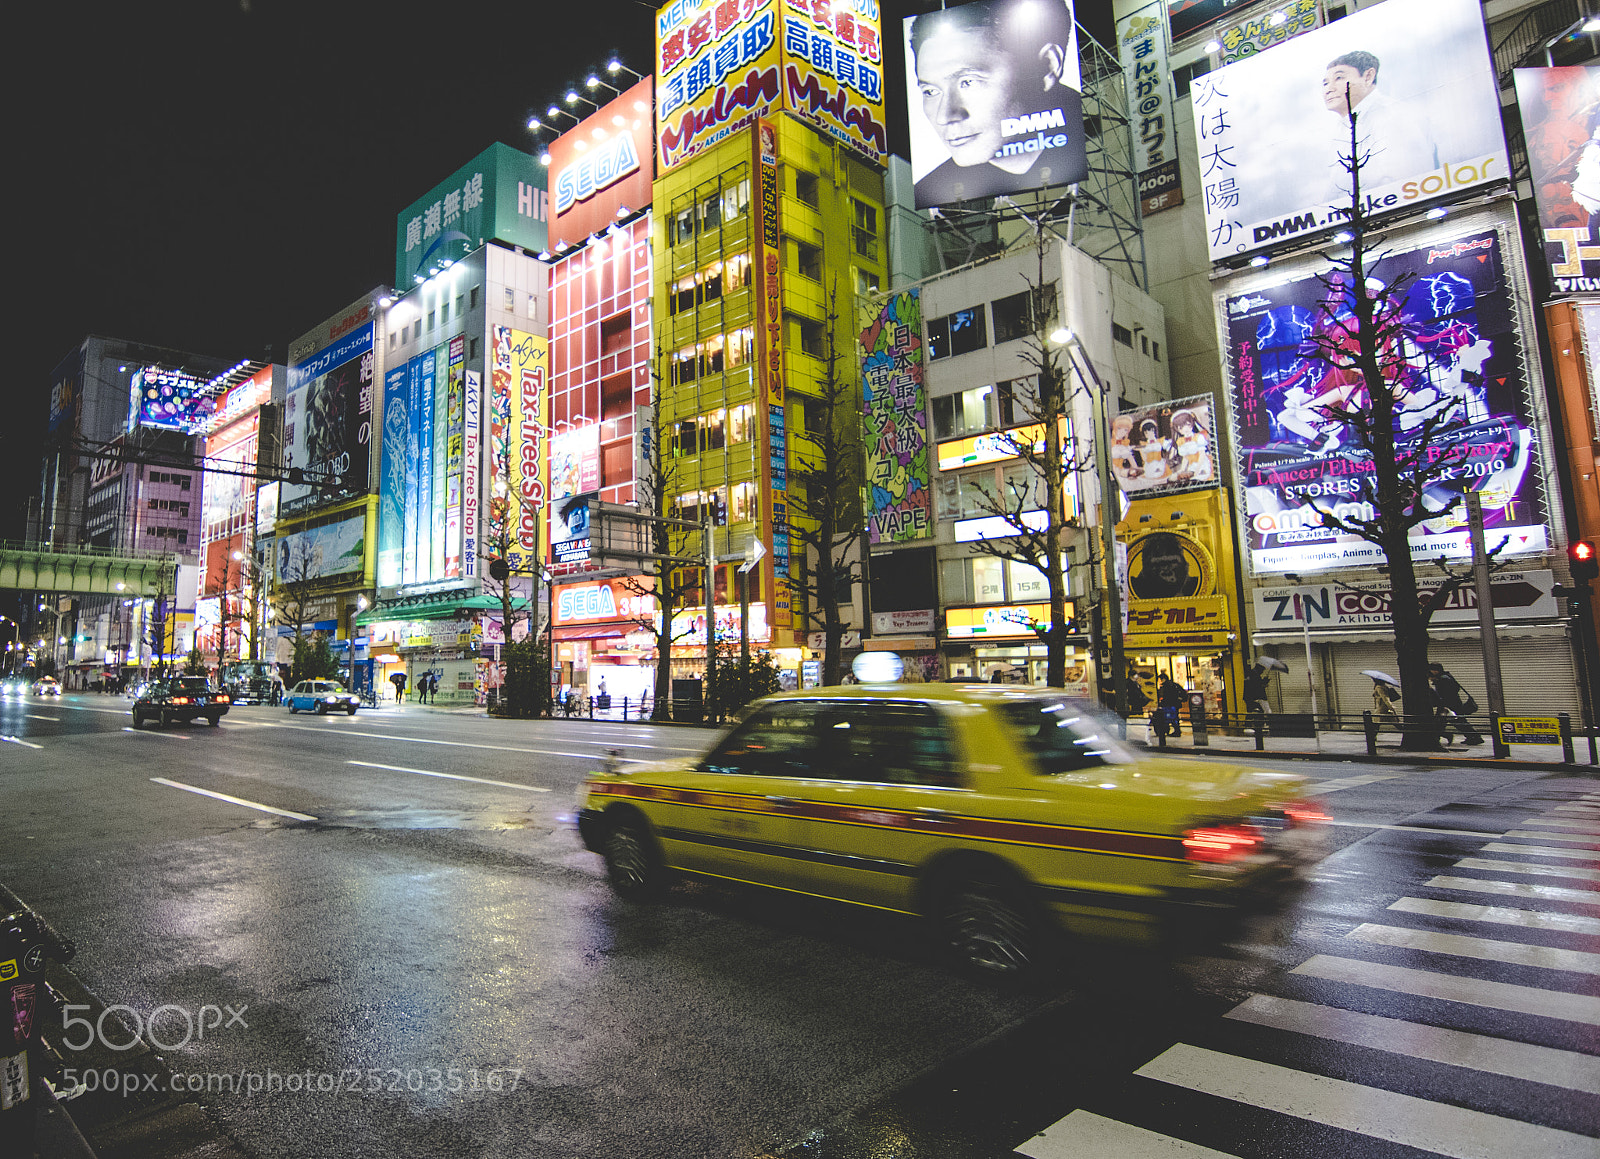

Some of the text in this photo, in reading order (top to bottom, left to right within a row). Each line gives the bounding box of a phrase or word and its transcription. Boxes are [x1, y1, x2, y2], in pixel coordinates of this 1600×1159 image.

[661, 13, 771, 118] 高額買取
[785, 18, 879, 99] 高額買取
[660, 67, 781, 167] Mulan
[785, 64, 886, 154] Mulan
[1000, 108, 1066, 138] DMM
[704, 127, 730, 147] AKIBA
[829, 125, 851, 143] AKIBA
[995, 132, 1068, 158] .make
[556, 132, 638, 212] SEGA
[1194, 74, 1247, 253] 次は太陽か。
[1149, 194, 1169, 210] 3F
[1253, 158, 1495, 243] DMM.mke solar
[466, 374, 479, 418] AKKY
[894, 323, 918, 451] 日本最大級
[870, 363, 896, 481] 電子タバコ
[466, 433, 479, 495] Tax-free
[1285, 478, 1360, 500] STORES
[1462, 460, 1505, 478] 2019
[465, 498, 477, 535] Shop
[873, 507, 926, 535] VAPE
[556, 542, 570, 553] SEGA
[1342, 549, 1373, 558] Anime
[1430, 541, 1458, 551] more
[559, 585, 616, 620] SEGA
[1262, 589, 1291, 597] COMIC
[1263, 587, 1331, 624] ZIN
